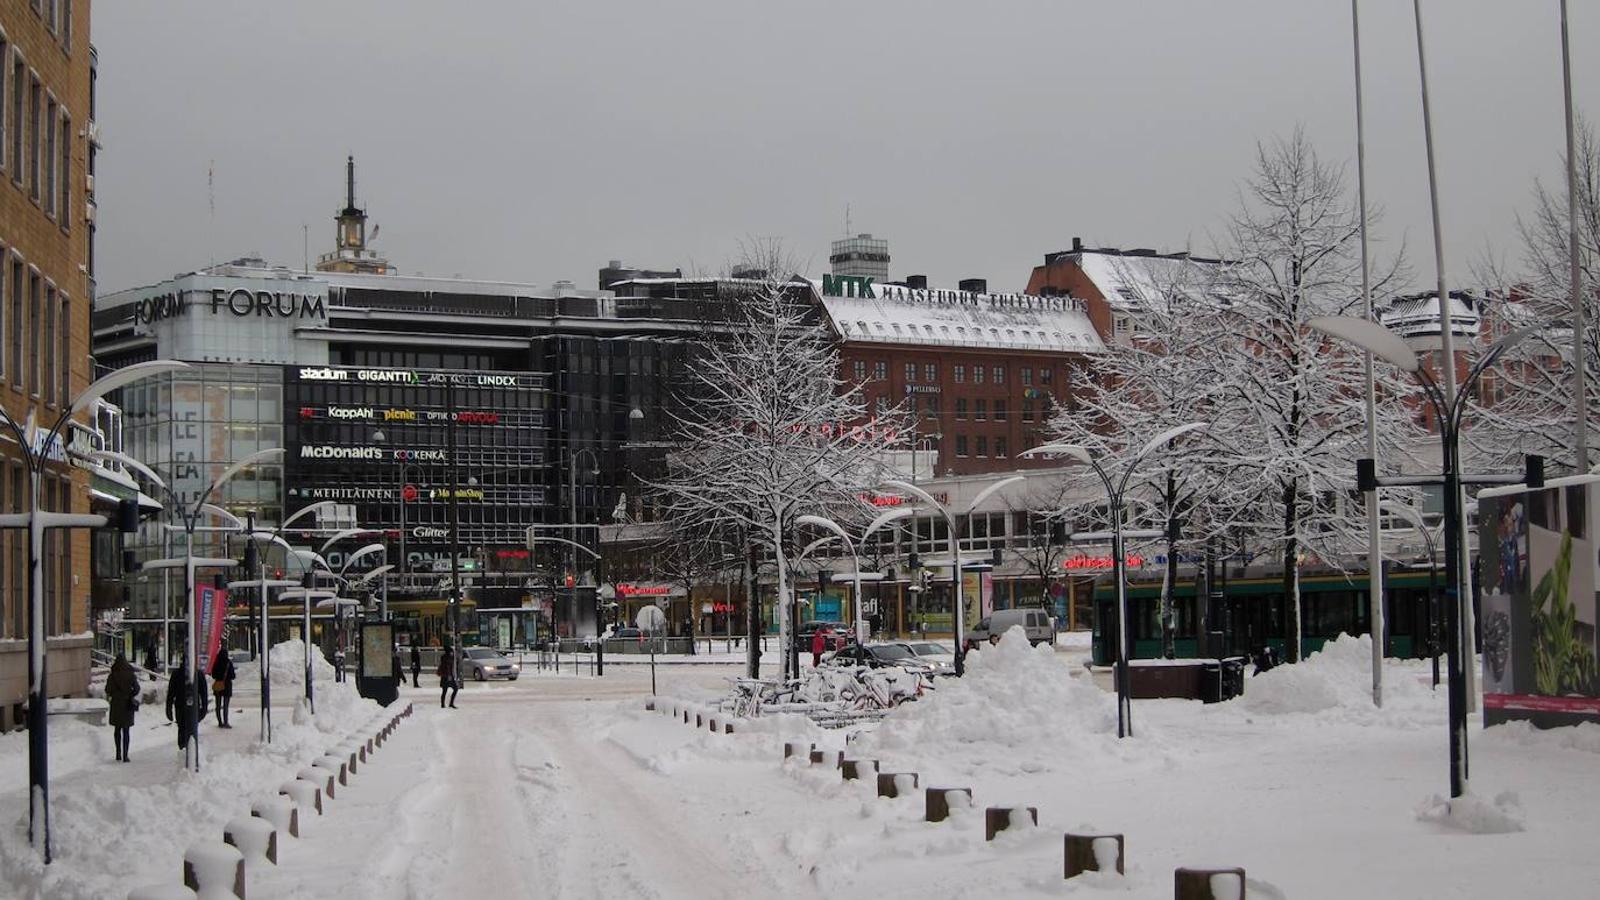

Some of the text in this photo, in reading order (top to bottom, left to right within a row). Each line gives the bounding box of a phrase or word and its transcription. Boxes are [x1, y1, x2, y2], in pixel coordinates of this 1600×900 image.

[823, 274, 876, 298] MTK
[883, 286, 979, 305] MAASEUDUN
[135, 289, 185, 326] FORUM
[212, 288, 326, 320] FORUM
[300, 368, 348, 380] stadium
[358, 370, 411, 382] GIGANTTI
[478, 375, 517, 386] LINDEX
[328, 406, 374, 419] KappAhl
[384, 408, 416, 421] picnic
[301, 445, 383, 459] McDonald's
[313, 487, 393, 499] MEHILÄINEN
[412, 526, 450, 538] Glitter
